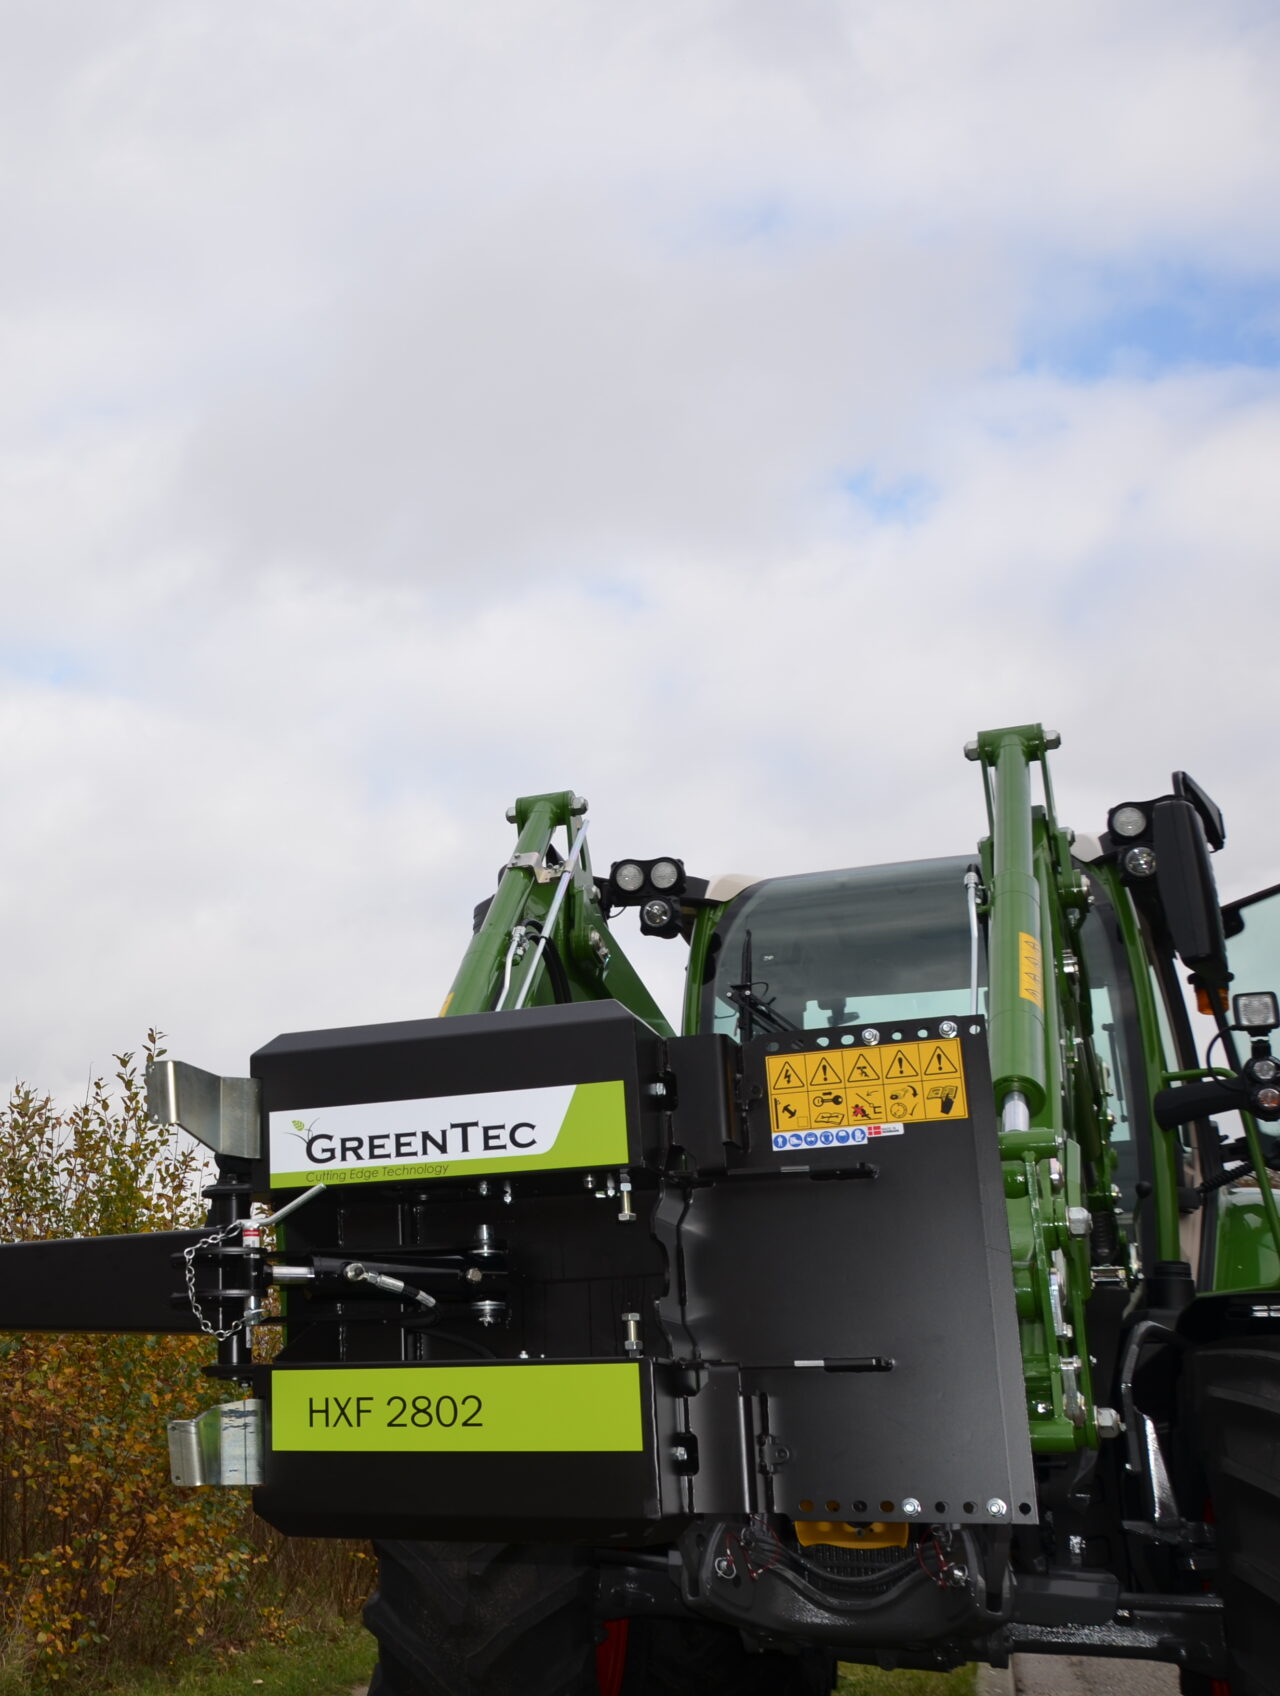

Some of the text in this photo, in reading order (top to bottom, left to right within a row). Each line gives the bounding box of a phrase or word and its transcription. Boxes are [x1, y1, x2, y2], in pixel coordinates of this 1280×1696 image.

[306, 1163, 449, 1183] Cutting Edge Technology
[309, 1395, 483, 1428] HXF 2802
